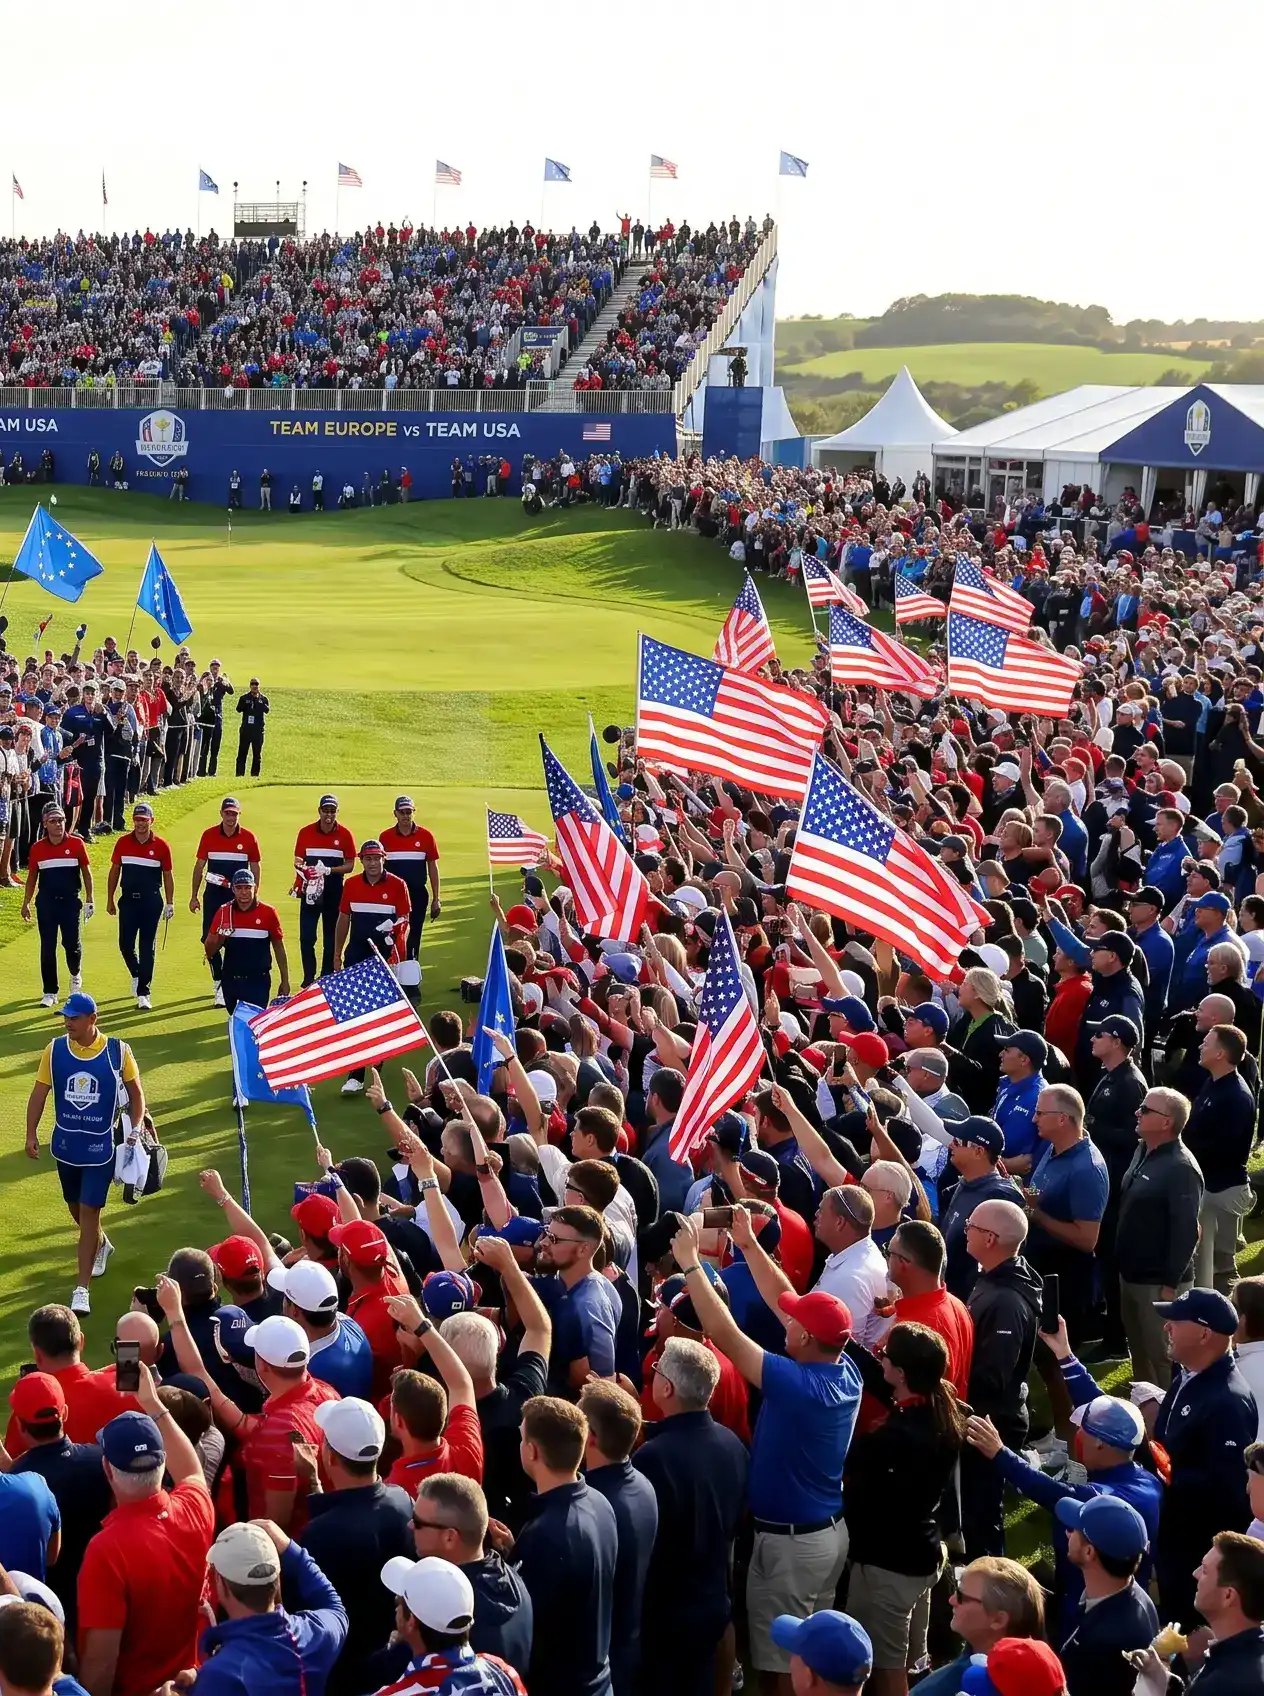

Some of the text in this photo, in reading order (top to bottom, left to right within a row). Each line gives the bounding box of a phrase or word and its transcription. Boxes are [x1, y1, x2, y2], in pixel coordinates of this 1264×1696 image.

[25, 418, 59, 432] USA
[270, 421, 319, 435] TEAM
[324, 421, 397, 436] EUROPE
[426, 422, 477, 437] TEAM
[483, 423, 521, 438] USA
